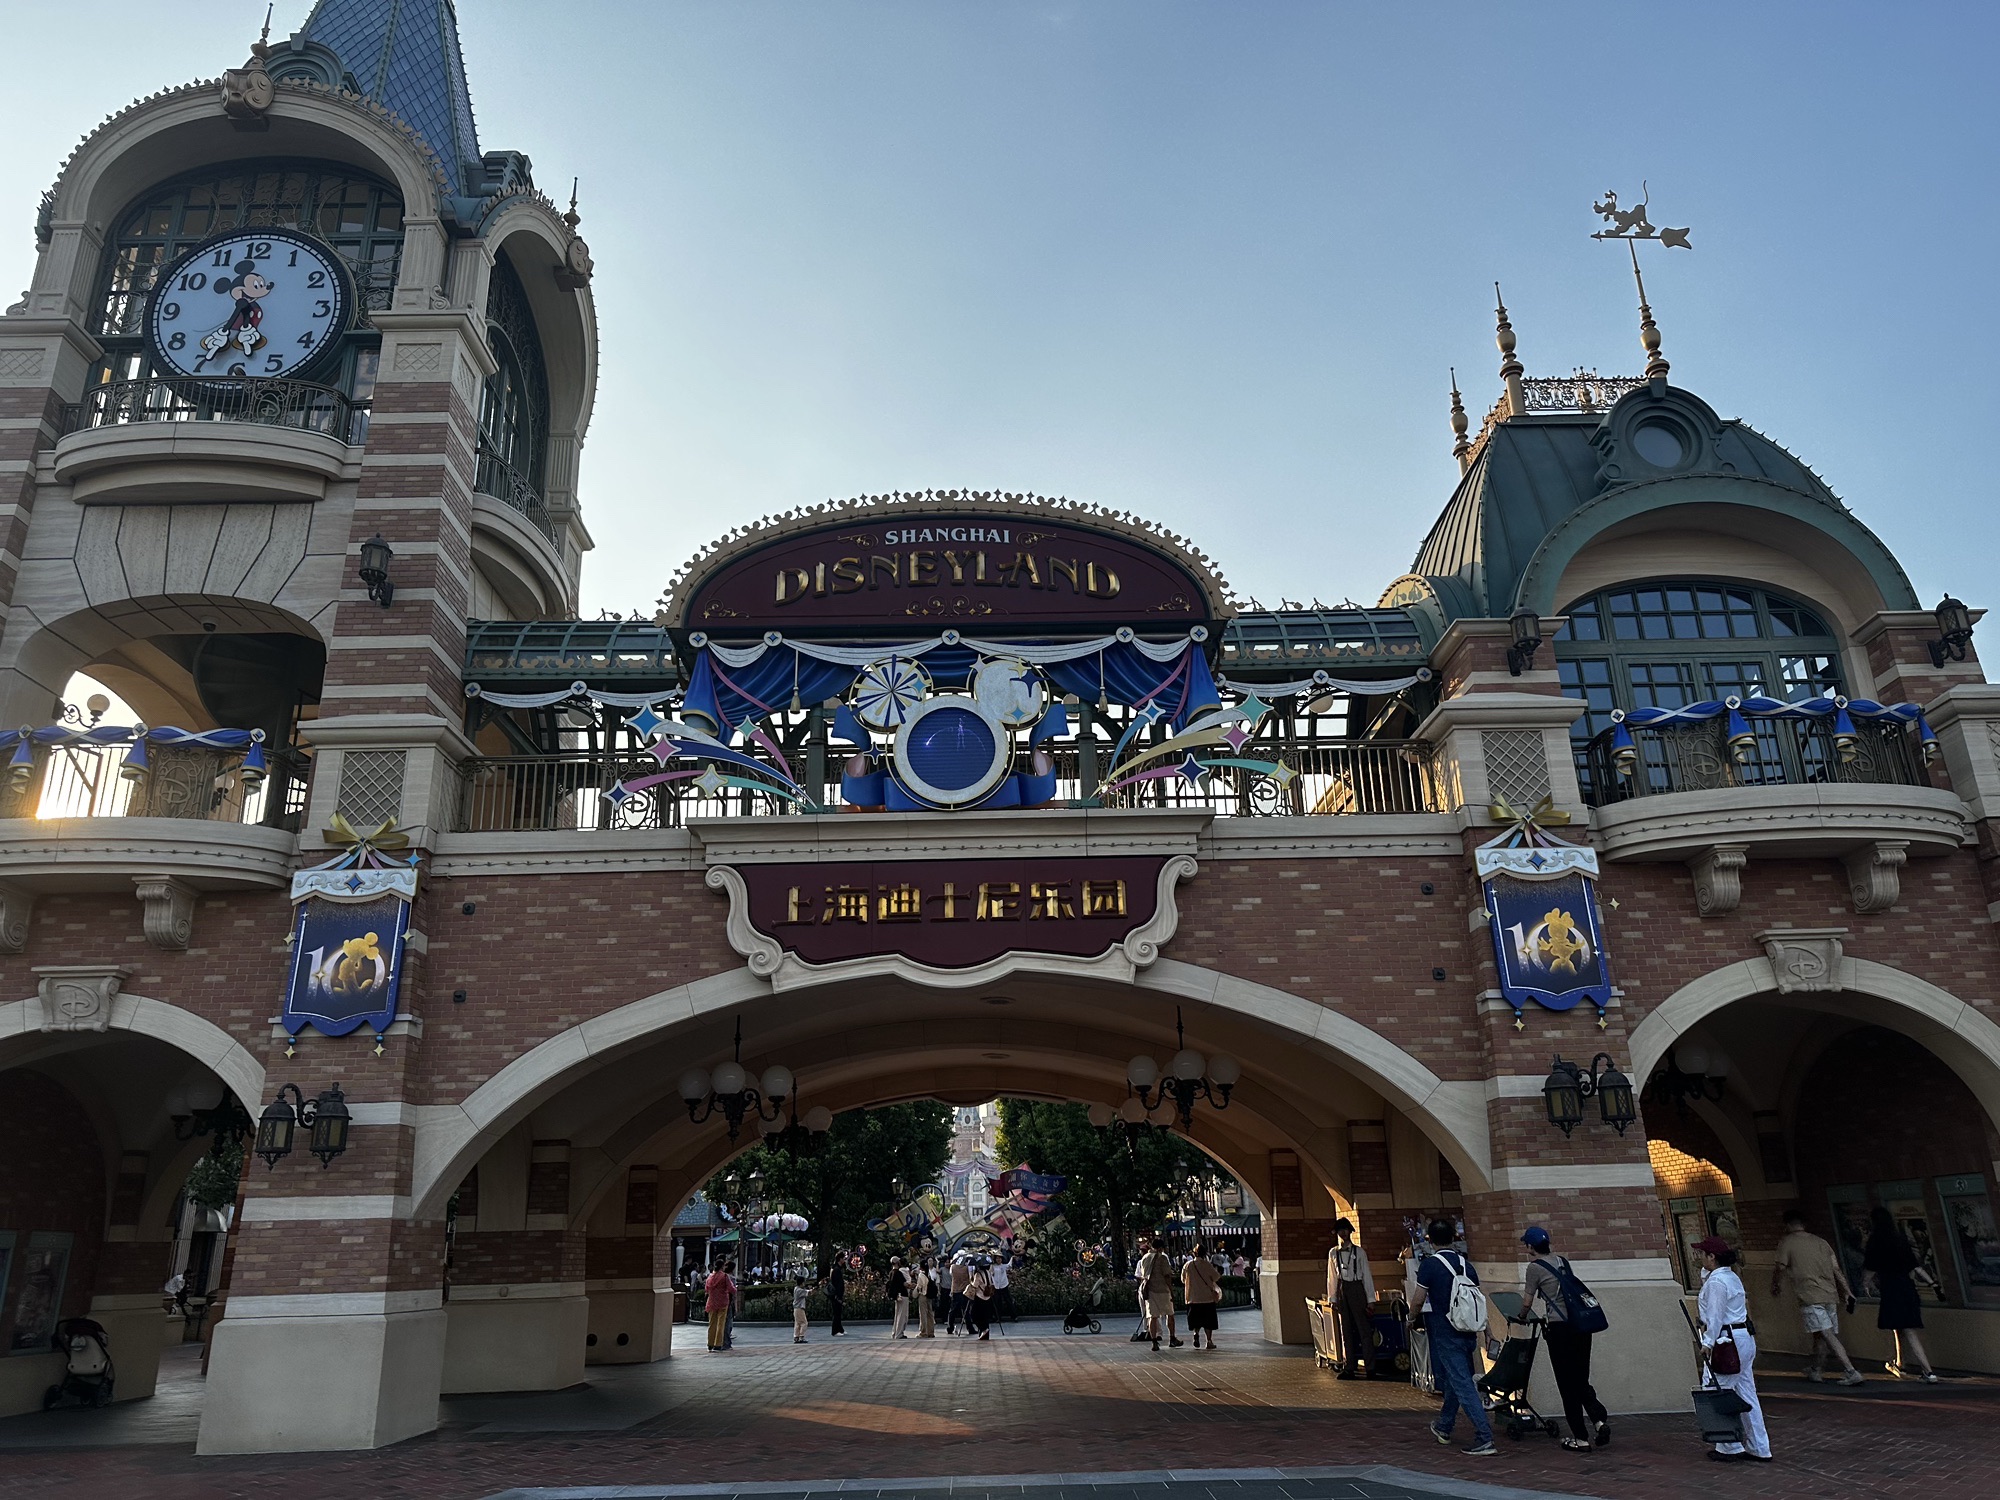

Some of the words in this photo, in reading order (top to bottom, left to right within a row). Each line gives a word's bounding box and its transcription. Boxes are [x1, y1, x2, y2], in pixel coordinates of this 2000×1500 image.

[211, 249, 233, 267] 11
[244, 242, 272, 259] 12
[287, 250, 298, 267] 1
[178, 272, 207, 291] 10
[306, 271, 326, 289] 2
[162, 302, 181, 321] 9
[312, 300, 331, 318] 3
[167, 332, 186, 350] 8
[297, 331, 315, 349] 4
[192, 355, 209, 373] 7
[264, 354, 283, 373] 5
[884, 527, 1012, 546] SHANGHAI
[774, 550, 1122, 607] DISNEYLAND
[771, 878, 1129, 929] 上海迪士尼乐园
